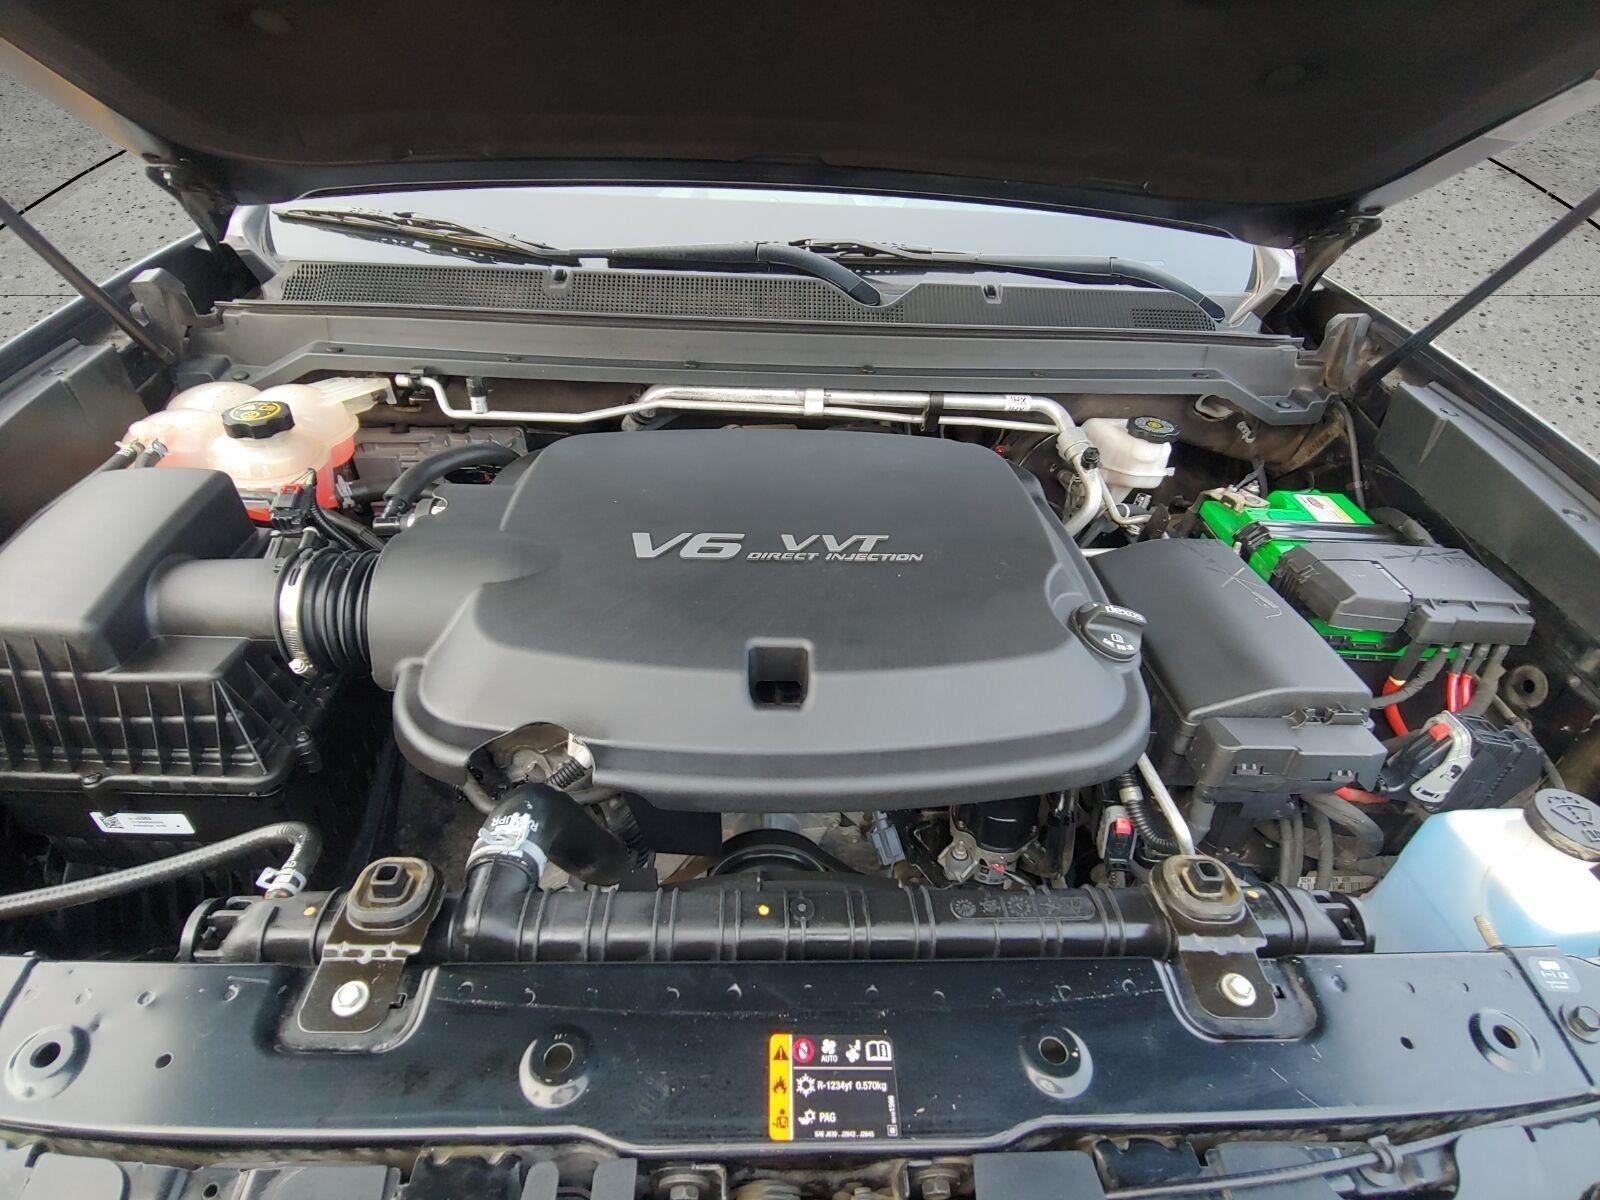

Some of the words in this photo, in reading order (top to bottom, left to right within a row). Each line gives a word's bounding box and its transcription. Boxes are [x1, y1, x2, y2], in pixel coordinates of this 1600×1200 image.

[632, 532, 746, 560] V6
[781, 534, 890, 551] VVT
[746, 552, 819, 561] DIRECT
[825, 552, 924, 562] INJECTION
[821, 1054, 838, 1063] AUTO
[816, 1081, 853, 1092] R-1234yf
[855, 1081, 887, 1092] 0.570kg
[819, 1112, 837, 1123] PAG
